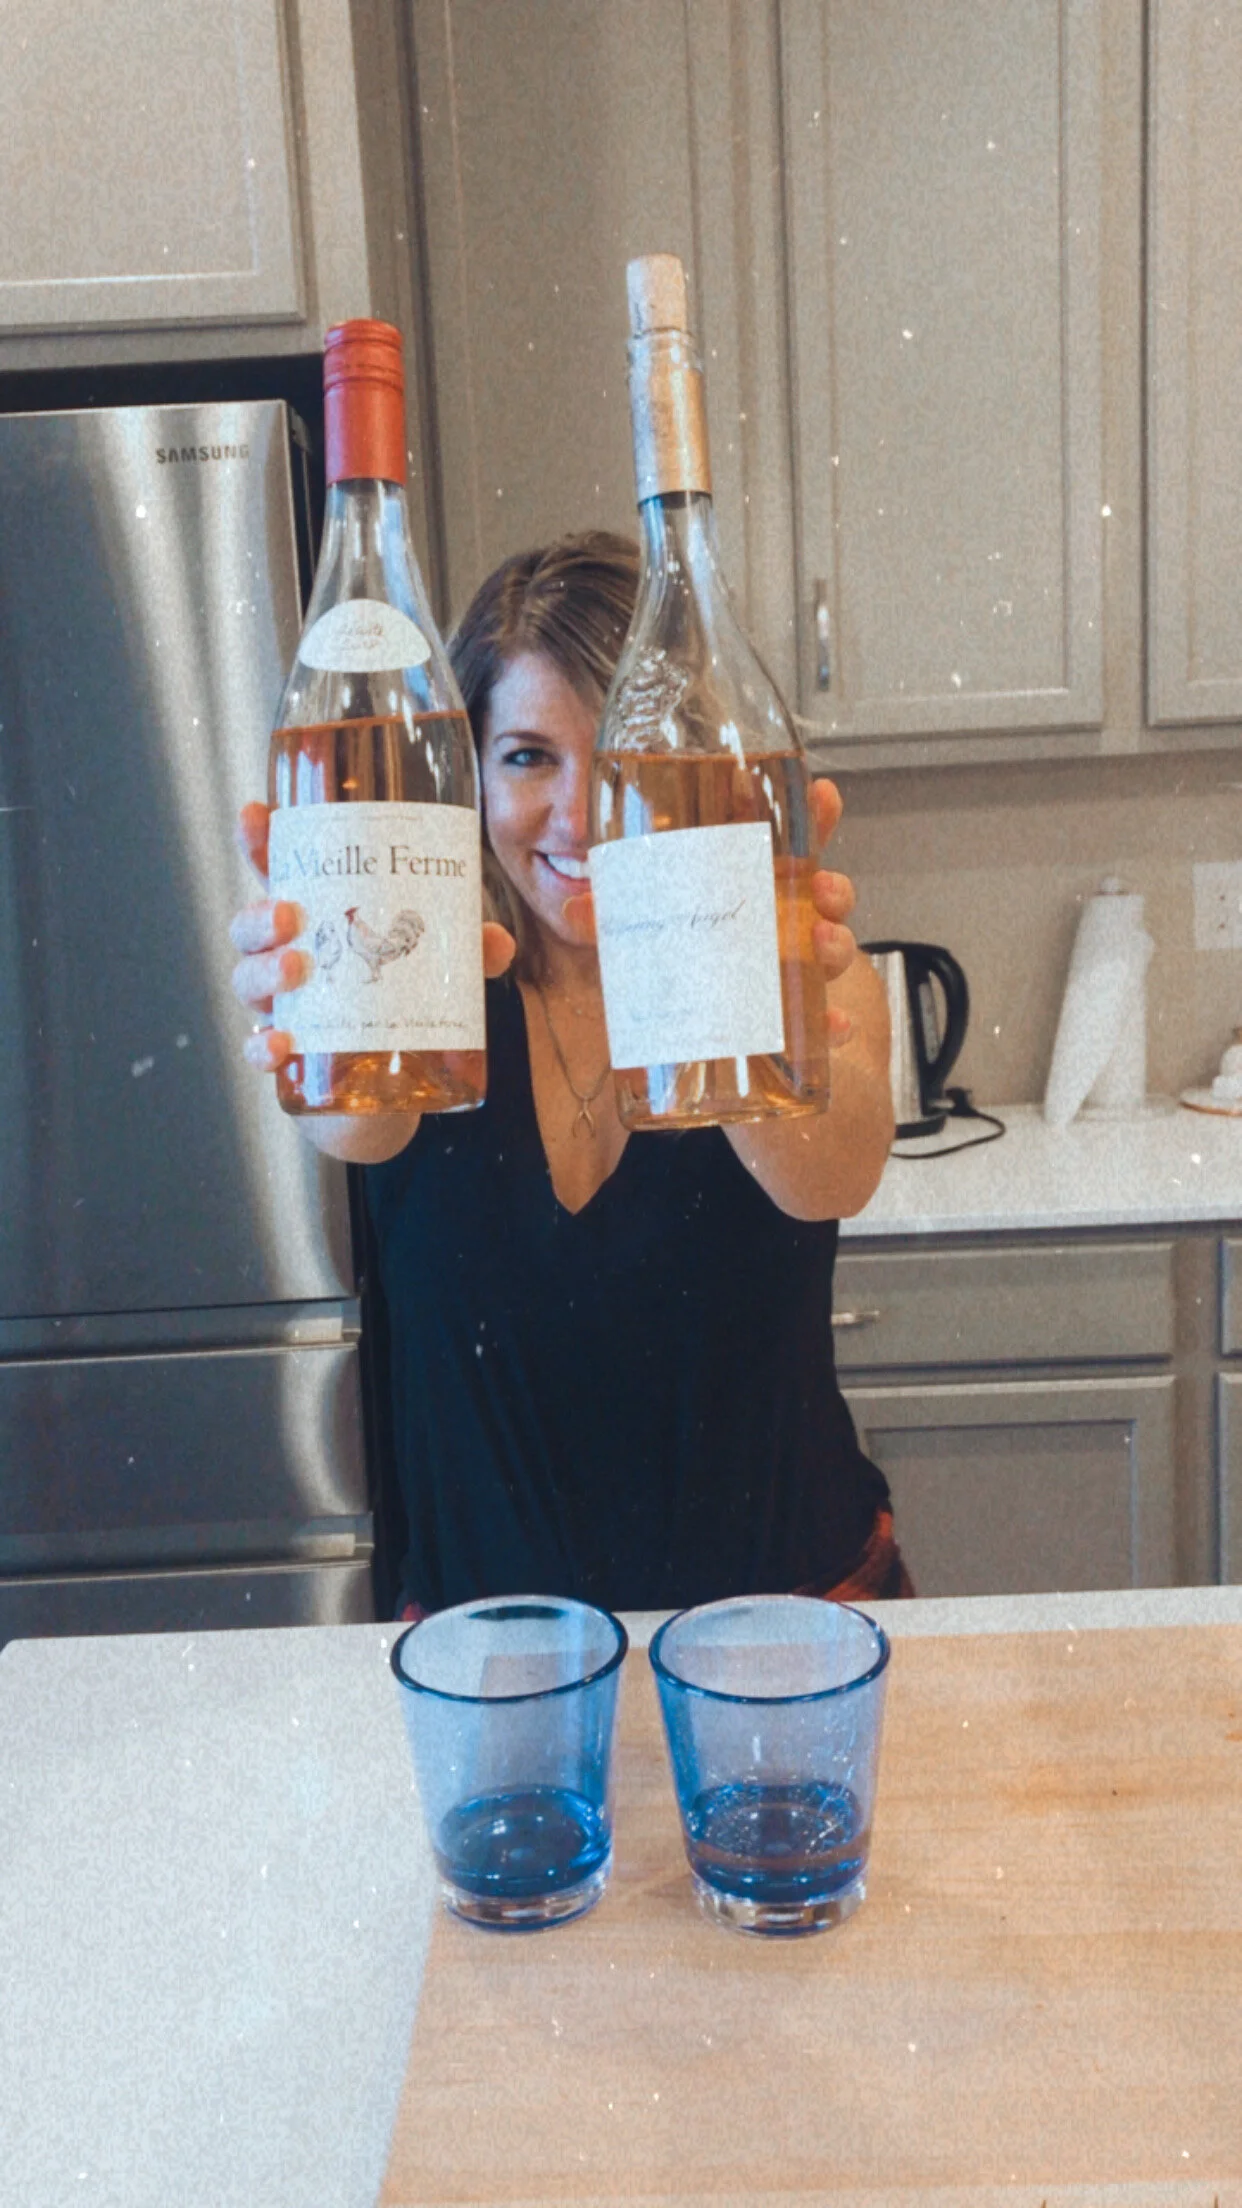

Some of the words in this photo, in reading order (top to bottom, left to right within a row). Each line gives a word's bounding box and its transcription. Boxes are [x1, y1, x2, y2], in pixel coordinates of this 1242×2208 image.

[155, 444, 249, 465] SAMSUNG
[292, 844, 378, 877] Vieille
[388, 844, 468, 879] Ferme
